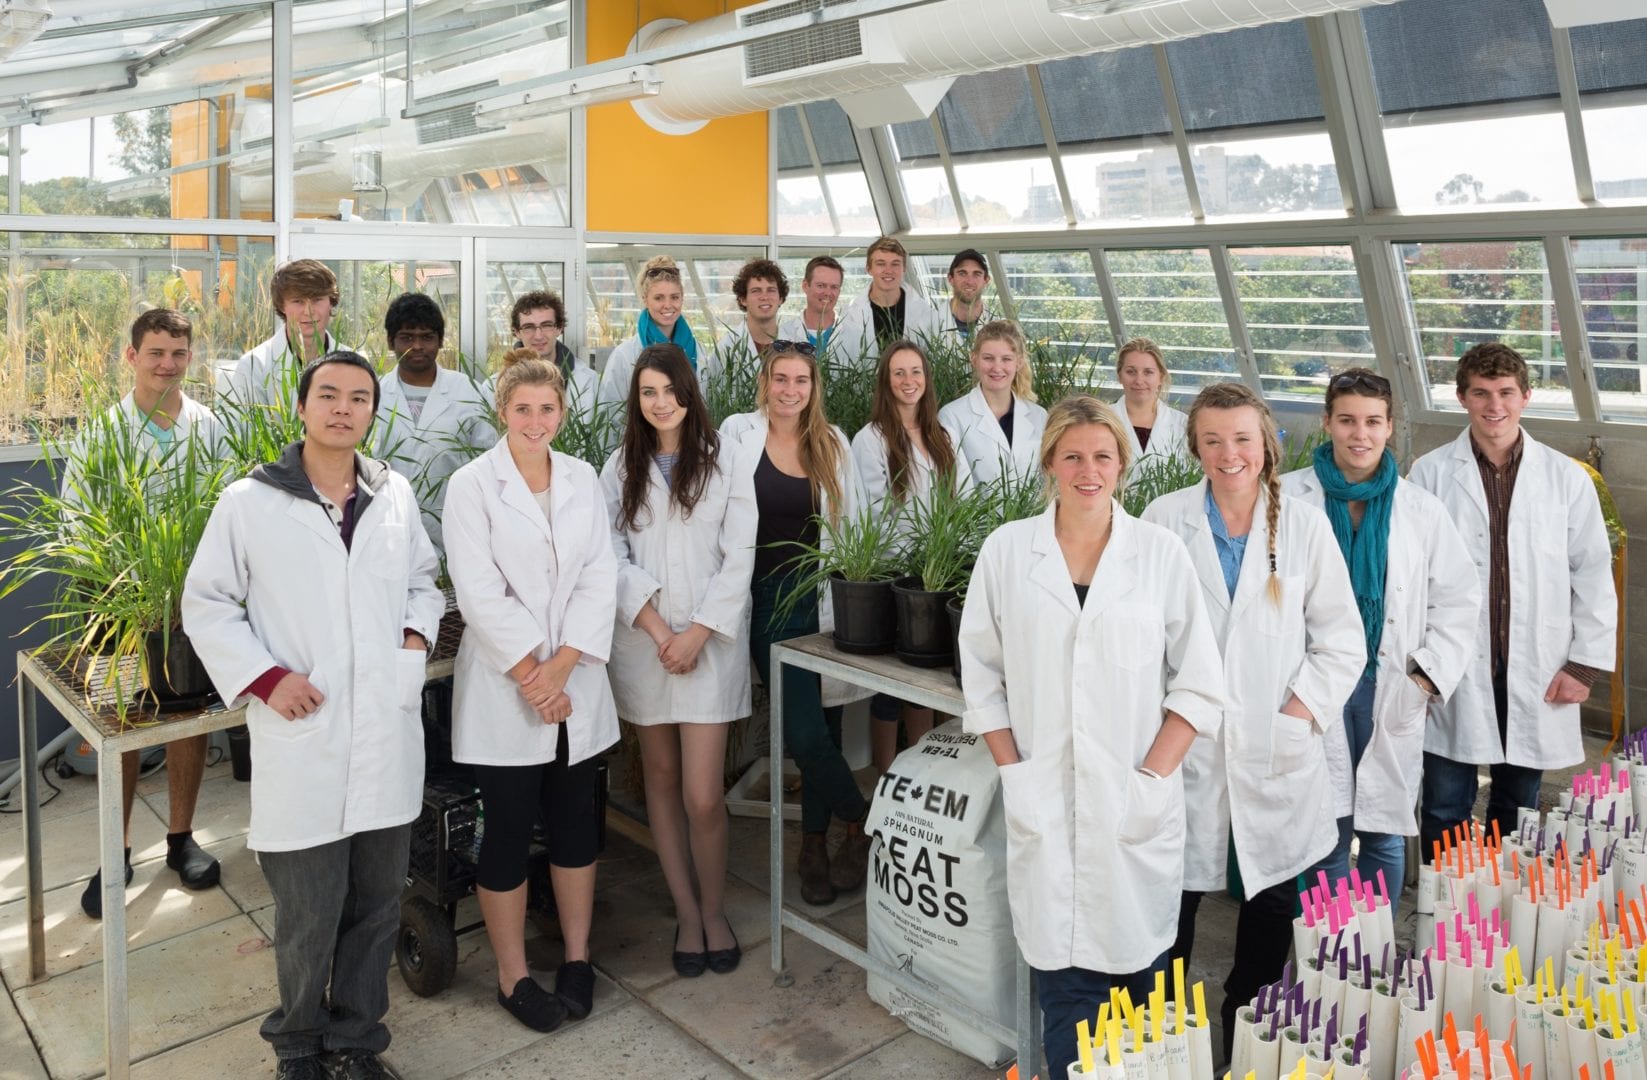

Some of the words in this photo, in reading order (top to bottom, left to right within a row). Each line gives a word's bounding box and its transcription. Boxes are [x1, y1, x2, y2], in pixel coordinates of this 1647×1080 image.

[883, 816, 943, 846] SPHAGNUM
[906, 814, 935, 830] NATURAL
[874, 853, 969, 928] MOSS
[910, 921, 922, 932] PEAT
[922, 928, 937, 939] MOSS
